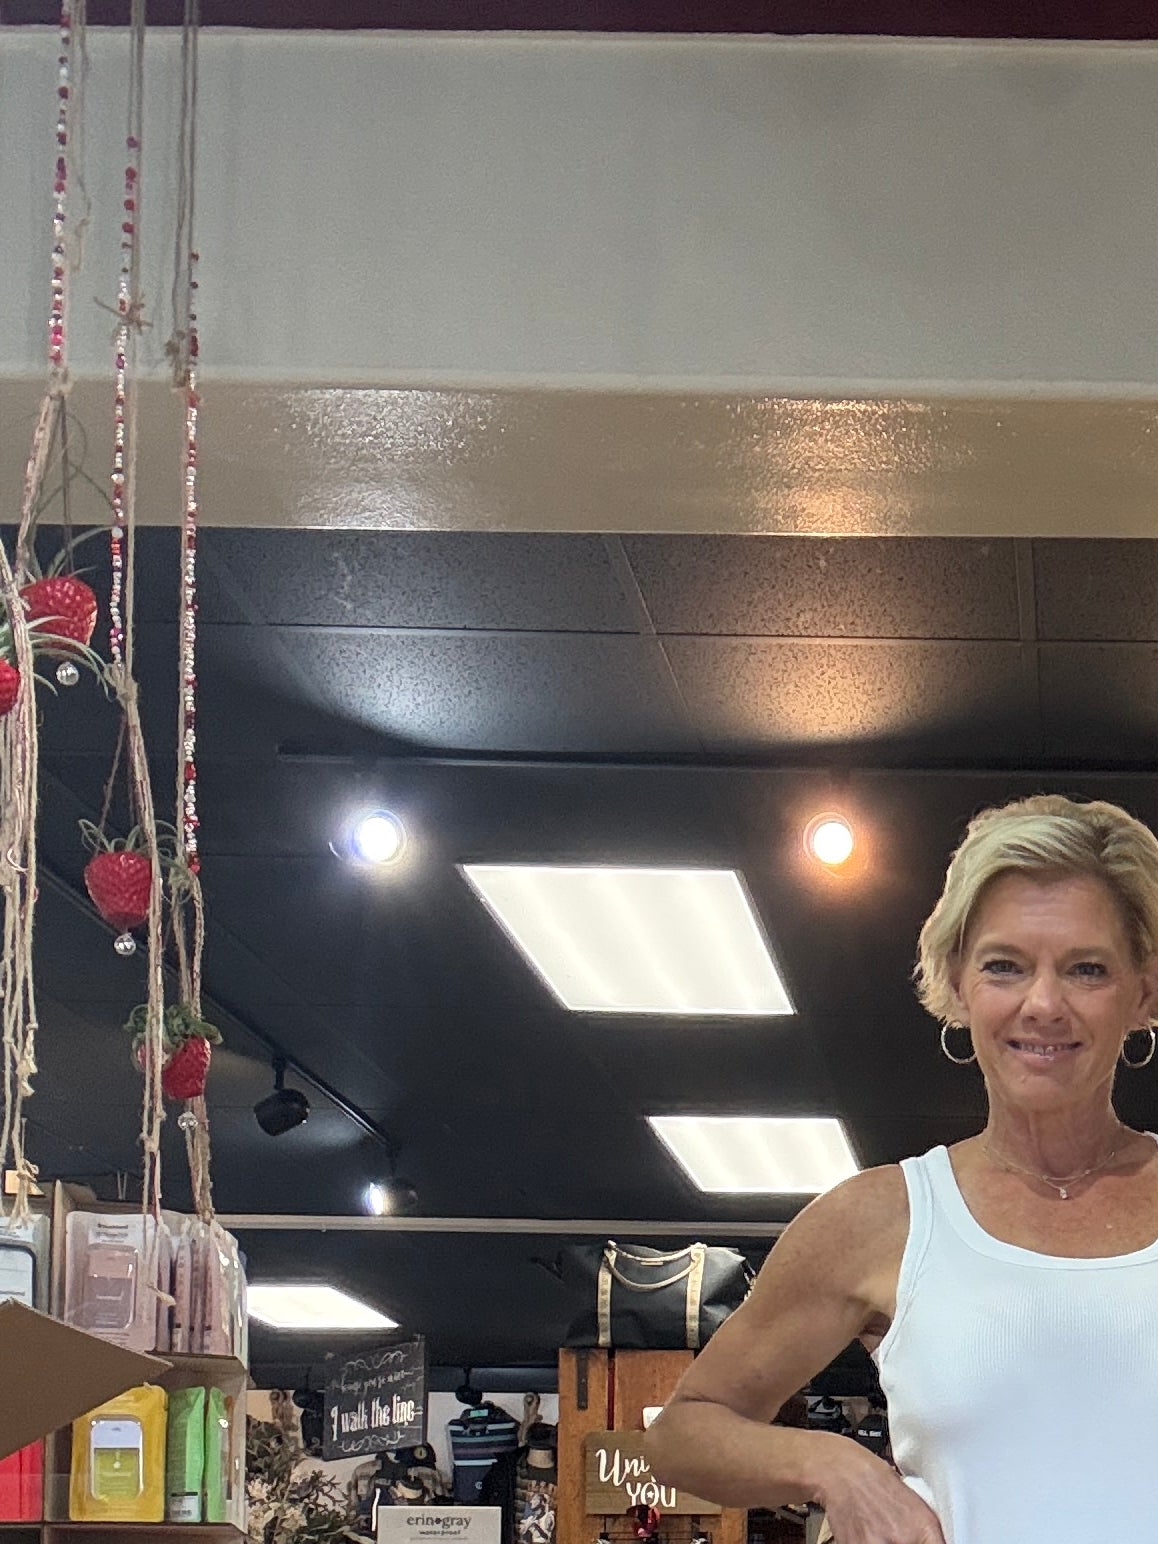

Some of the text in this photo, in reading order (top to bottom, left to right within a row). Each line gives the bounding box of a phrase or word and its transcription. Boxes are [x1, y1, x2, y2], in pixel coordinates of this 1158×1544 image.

[341, 1400, 368, 1433] walk
[371, 1396, 390, 1429] the
[392, 1394, 414, 1426] line
[595, 1448, 650, 1487] Uni
